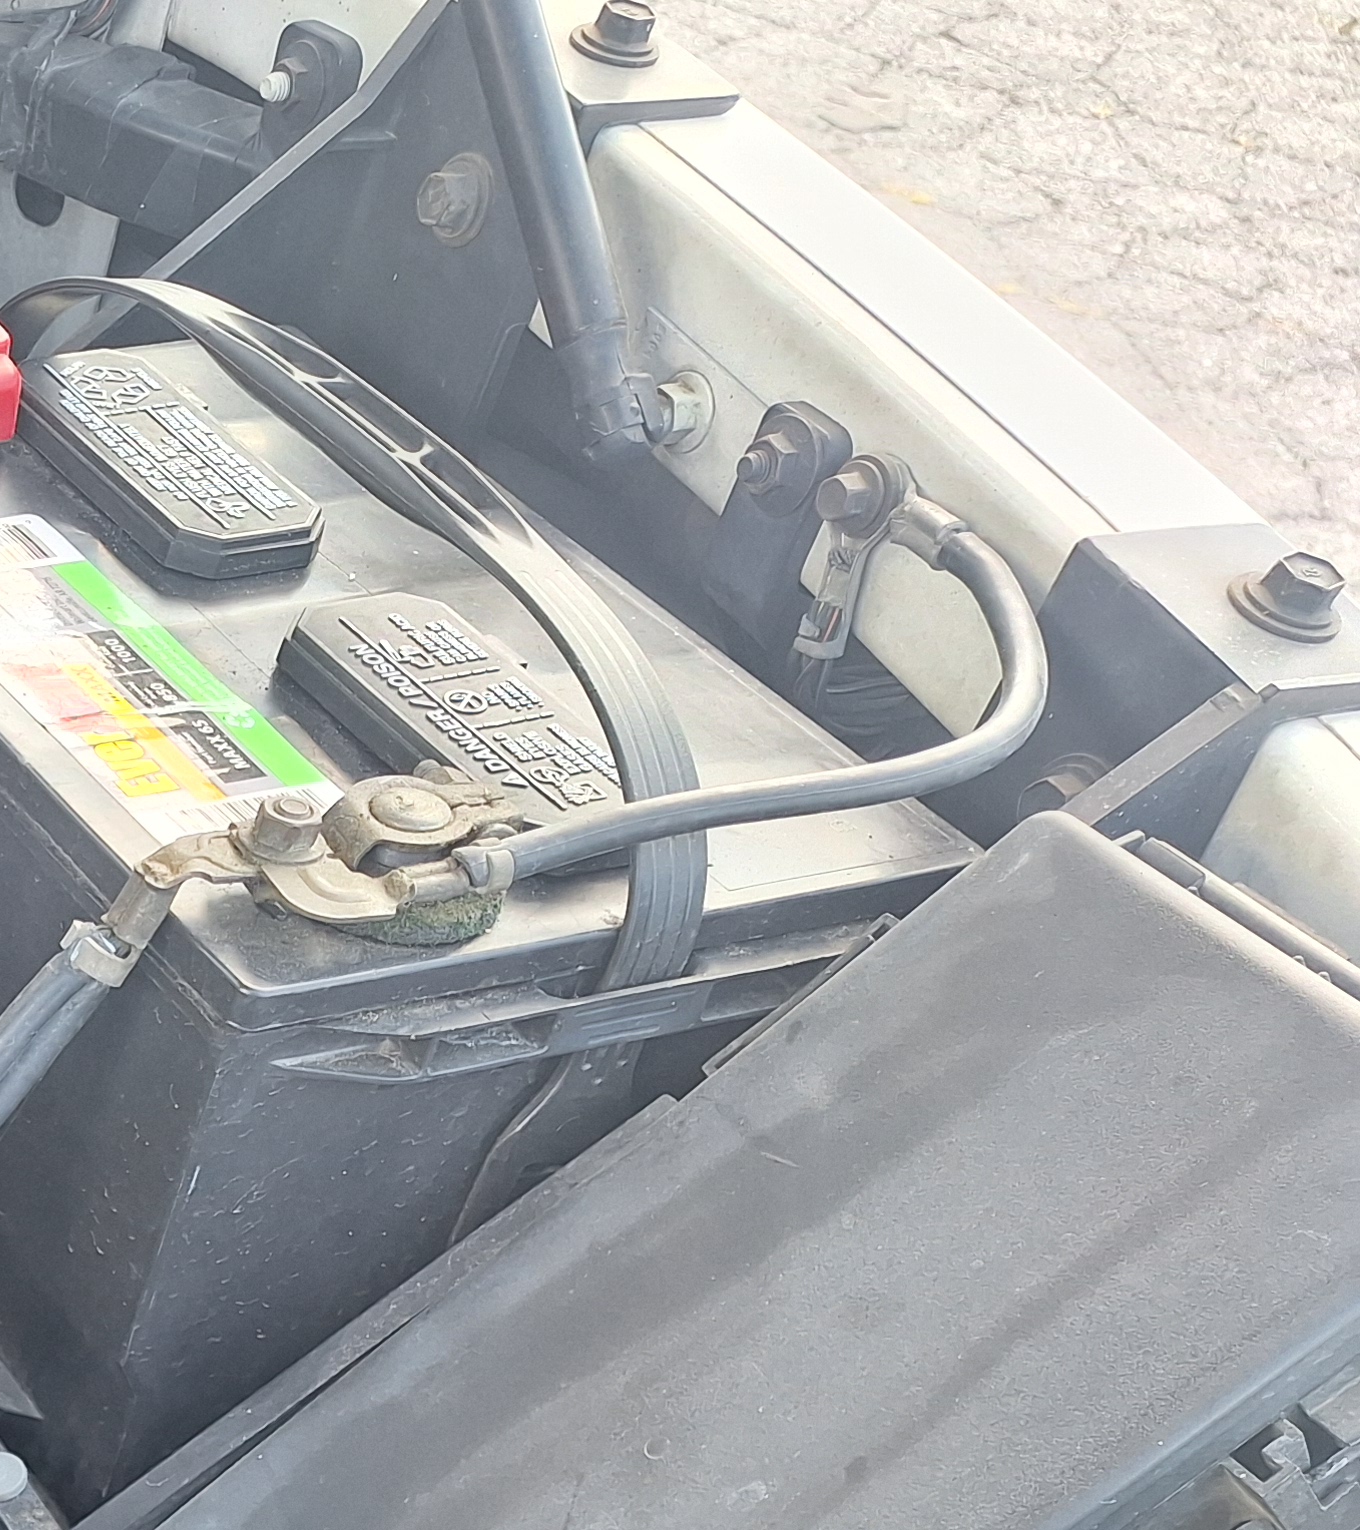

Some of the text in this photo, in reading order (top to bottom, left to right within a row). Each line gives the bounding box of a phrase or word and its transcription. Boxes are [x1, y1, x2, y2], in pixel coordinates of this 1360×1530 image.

[103, 637, 136, 664] 1000
[349, 642, 424, 698] POISON
[149, 681, 177, 703] 850
[189, 717, 251, 773] MAXX 65
[426, 709, 509, 773] DANGER
